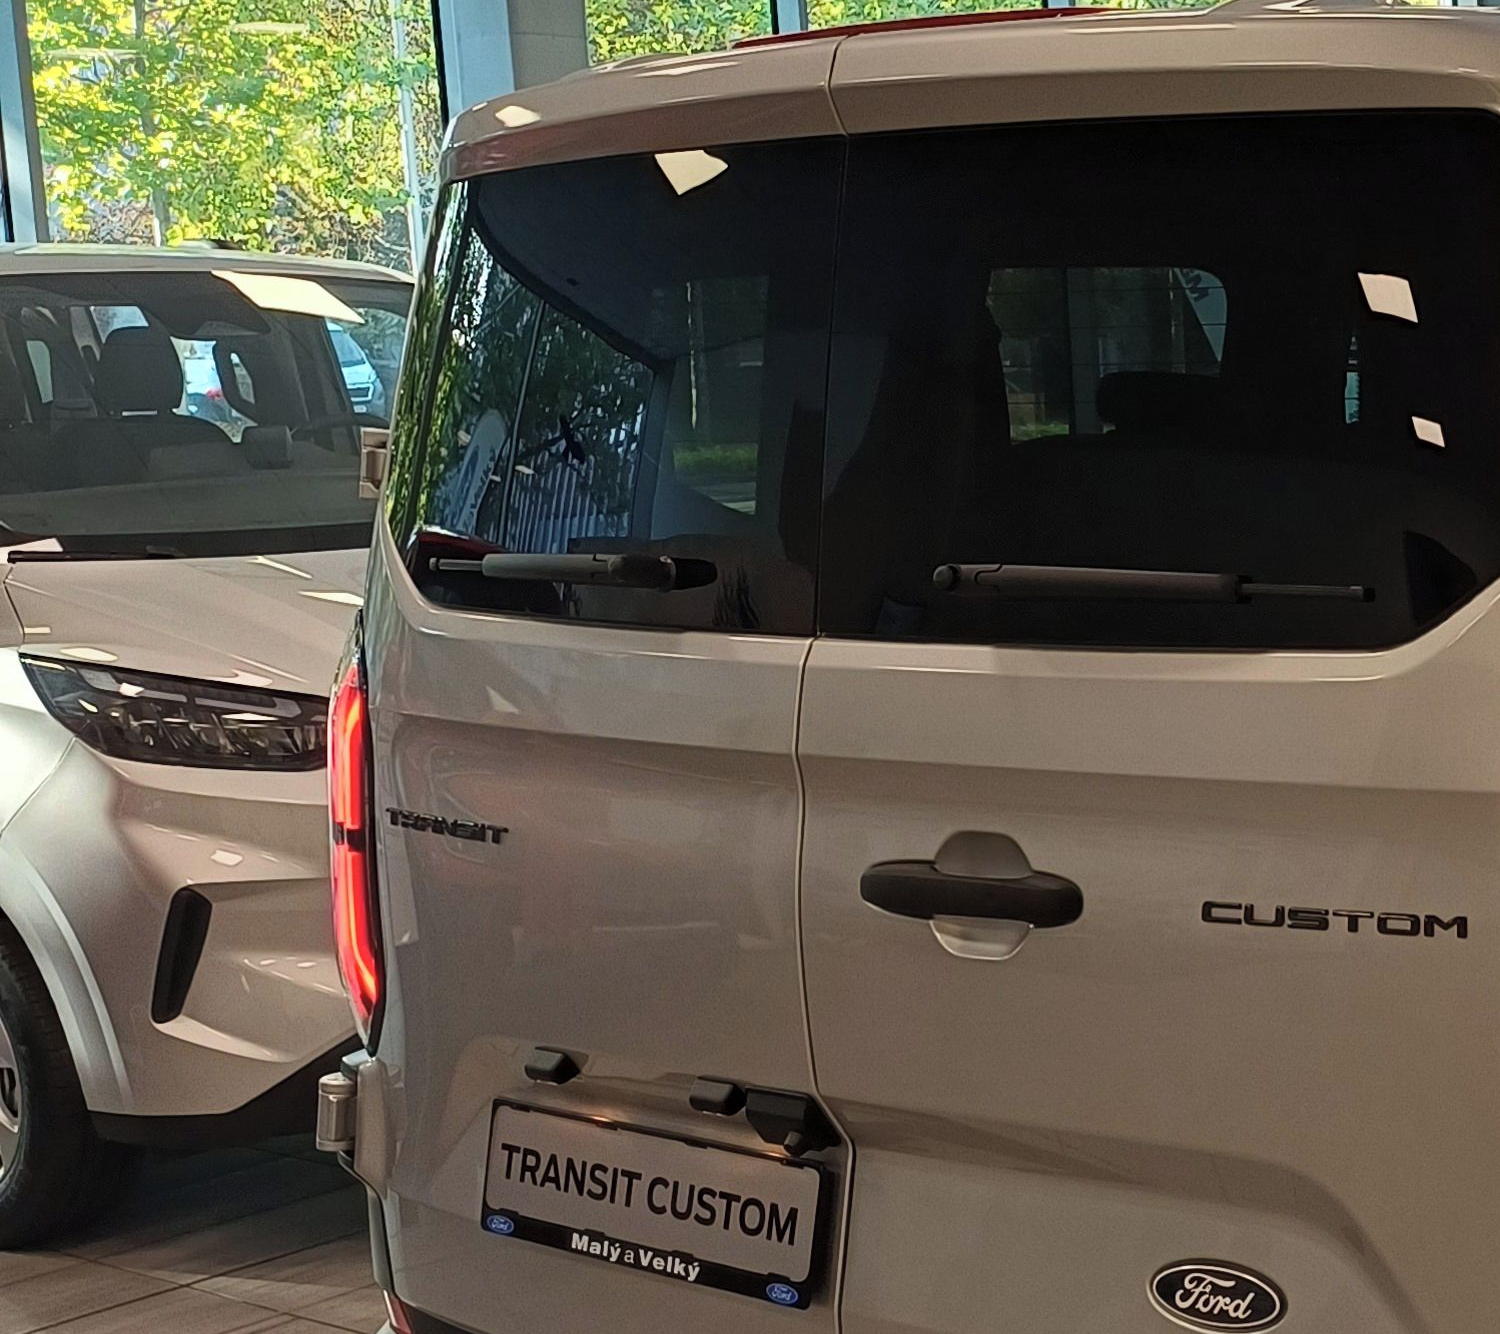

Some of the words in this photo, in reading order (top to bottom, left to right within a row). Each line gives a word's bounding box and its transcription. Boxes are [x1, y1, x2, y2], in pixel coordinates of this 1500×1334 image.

[385, 806, 509, 844] TRANSIT
[1200, 899, 1469, 940] CUSTOM
[500, 1142, 642, 1208] TRANSIT
[646, 1176, 799, 1246] CUSTOM
[571, 1232, 622, 1263] Malý
[623, 1249, 635, 1264] a
[638, 1248, 701, 1282] Velký
[1174, 1271, 1258, 1321] Ford
